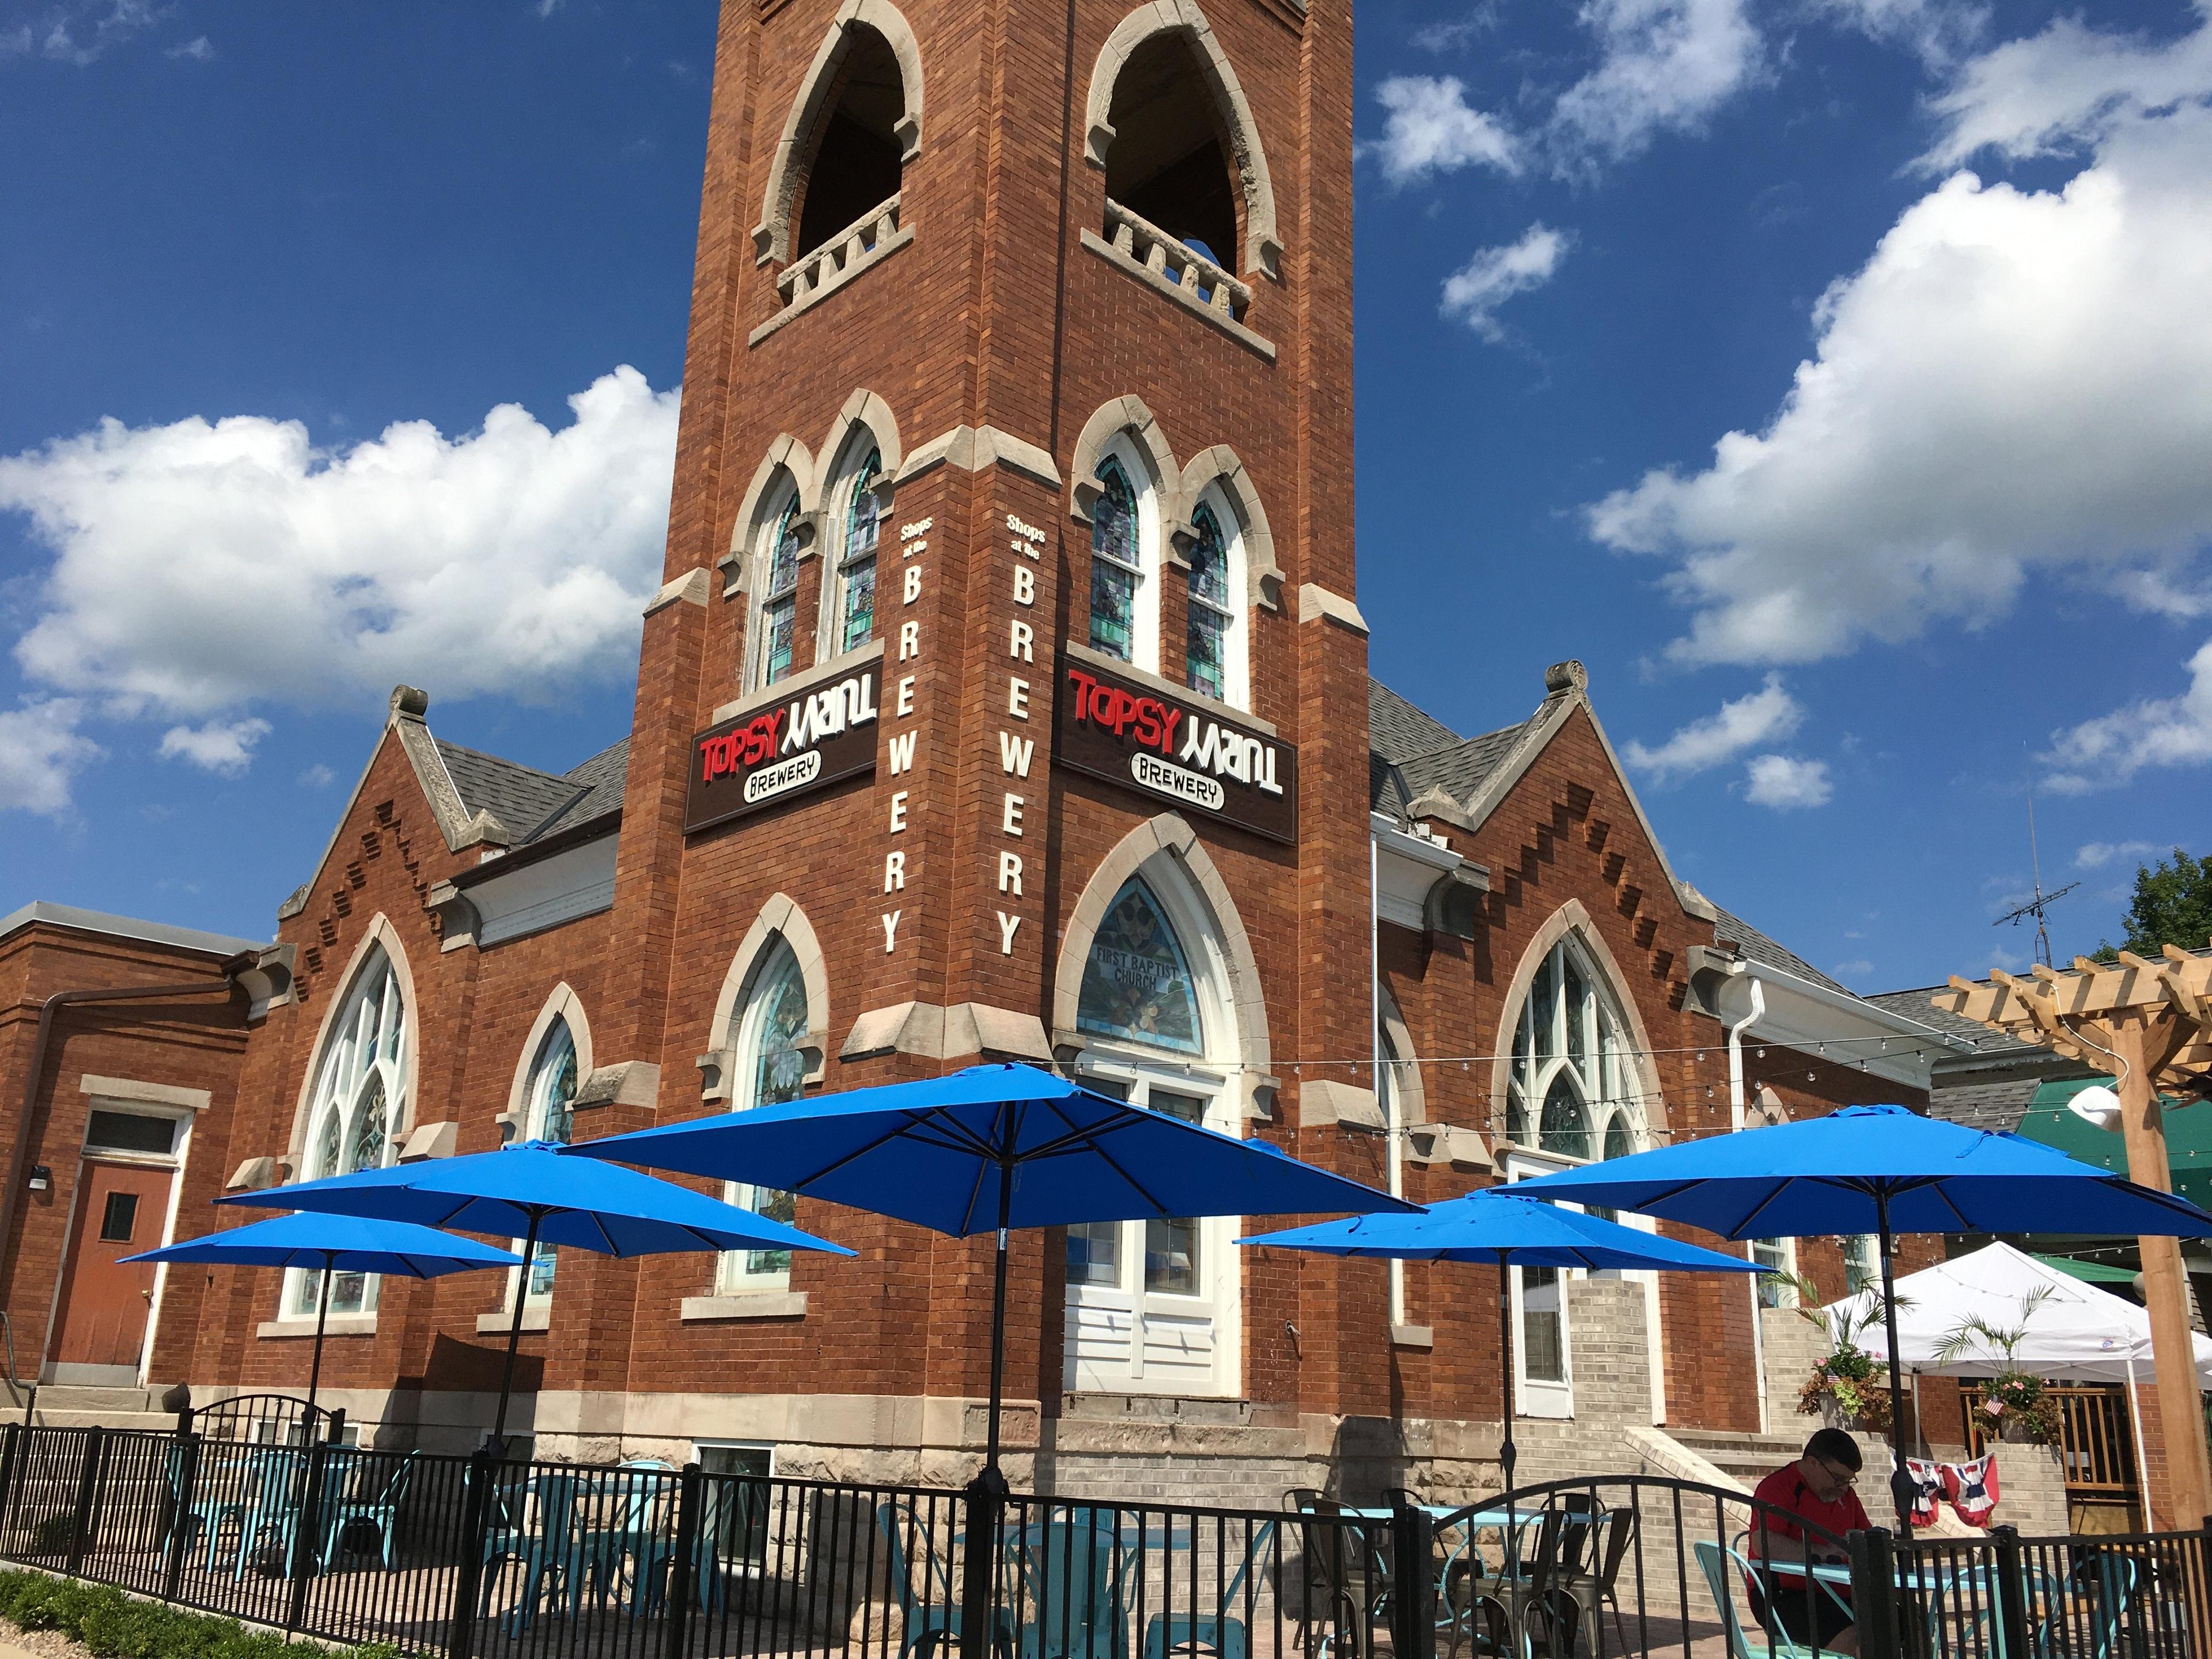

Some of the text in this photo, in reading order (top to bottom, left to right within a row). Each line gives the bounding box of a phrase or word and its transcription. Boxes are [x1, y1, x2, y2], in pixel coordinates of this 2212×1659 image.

[900, 517, 933, 541] Shops
[1007, 514, 1046, 543] Shops
[903, 540, 927, 558] at the
[1011, 540, 1040, 560] at the
[1069, 669, 1181, 754] TOPSY
[700, 708, 787, 782] TOPSY
[882, 565, 922, 953] BREWERY
[997, 565, 1035, 955] BREWERY
[751, 755, 816, 798] BREWERY
[1139, 757, 1217, 804] BREWERY
[1096, 946, 1180, 980] FIRST BAPTIST
[1114, 968, 1157, 991] CHURCH
